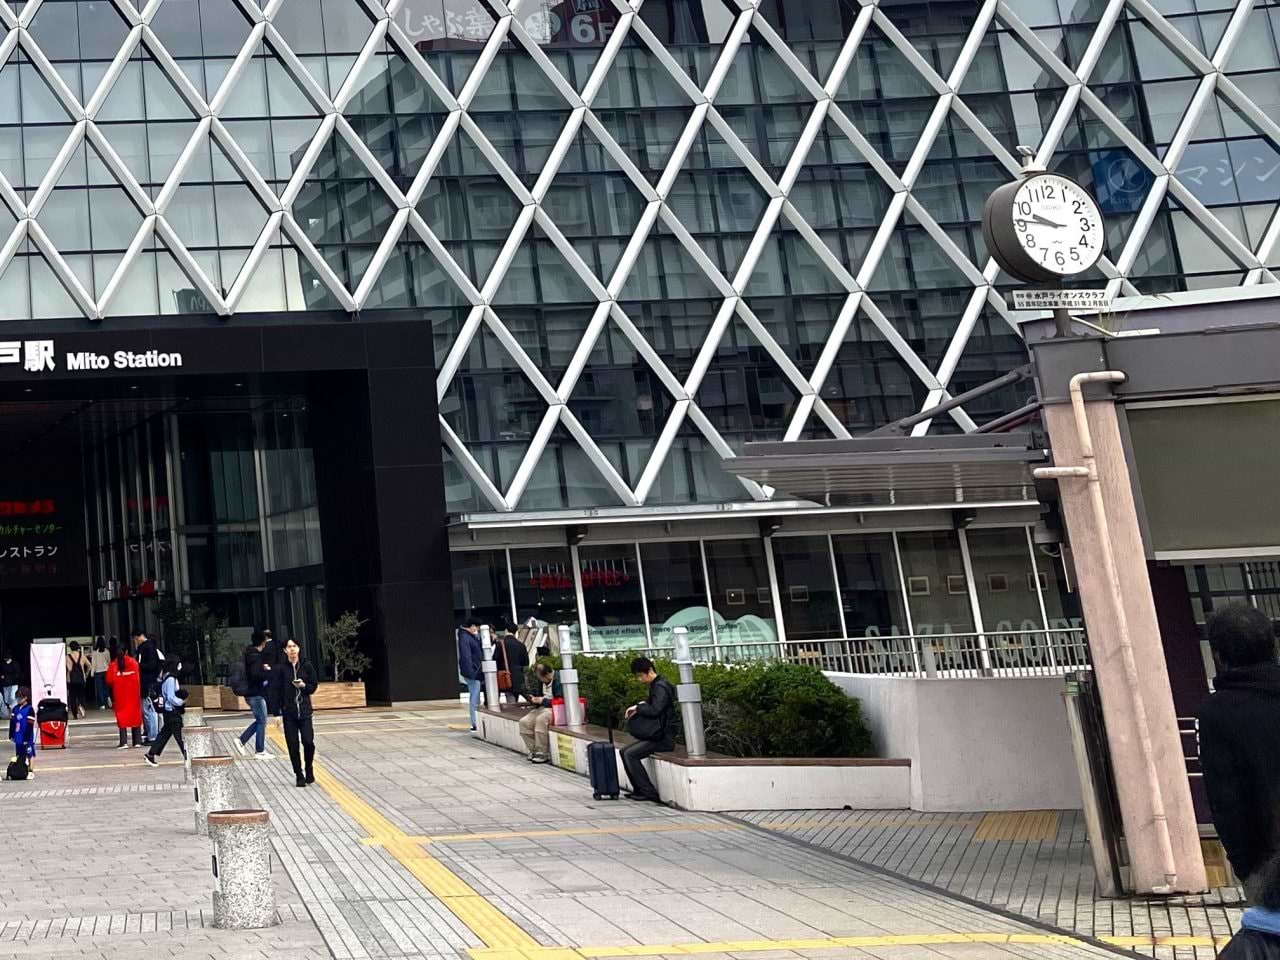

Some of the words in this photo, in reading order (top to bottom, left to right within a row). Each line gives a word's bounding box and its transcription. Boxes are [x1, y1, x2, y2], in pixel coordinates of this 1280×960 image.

[1028, 188, 1040, 202] 11
[1041, 185, 1056, 199] 12
[1017, 201, 1032, 216] 10
[1072, 200, 1083, 215] 2
[1017, 218, 1028, 232] 9
[1079, 217, 1090, 231] 3
[1025, 234, 1036, 248] 8
[1078, 234, 1089, 248] 4
[1039, 247, 1049, 261] 7
[1054, 251, 1065, 265] 6
[1069, 247, 1080, 261] 5
[67, 351, 110, 371] Mito
[113, 349, 183, 370] Station
